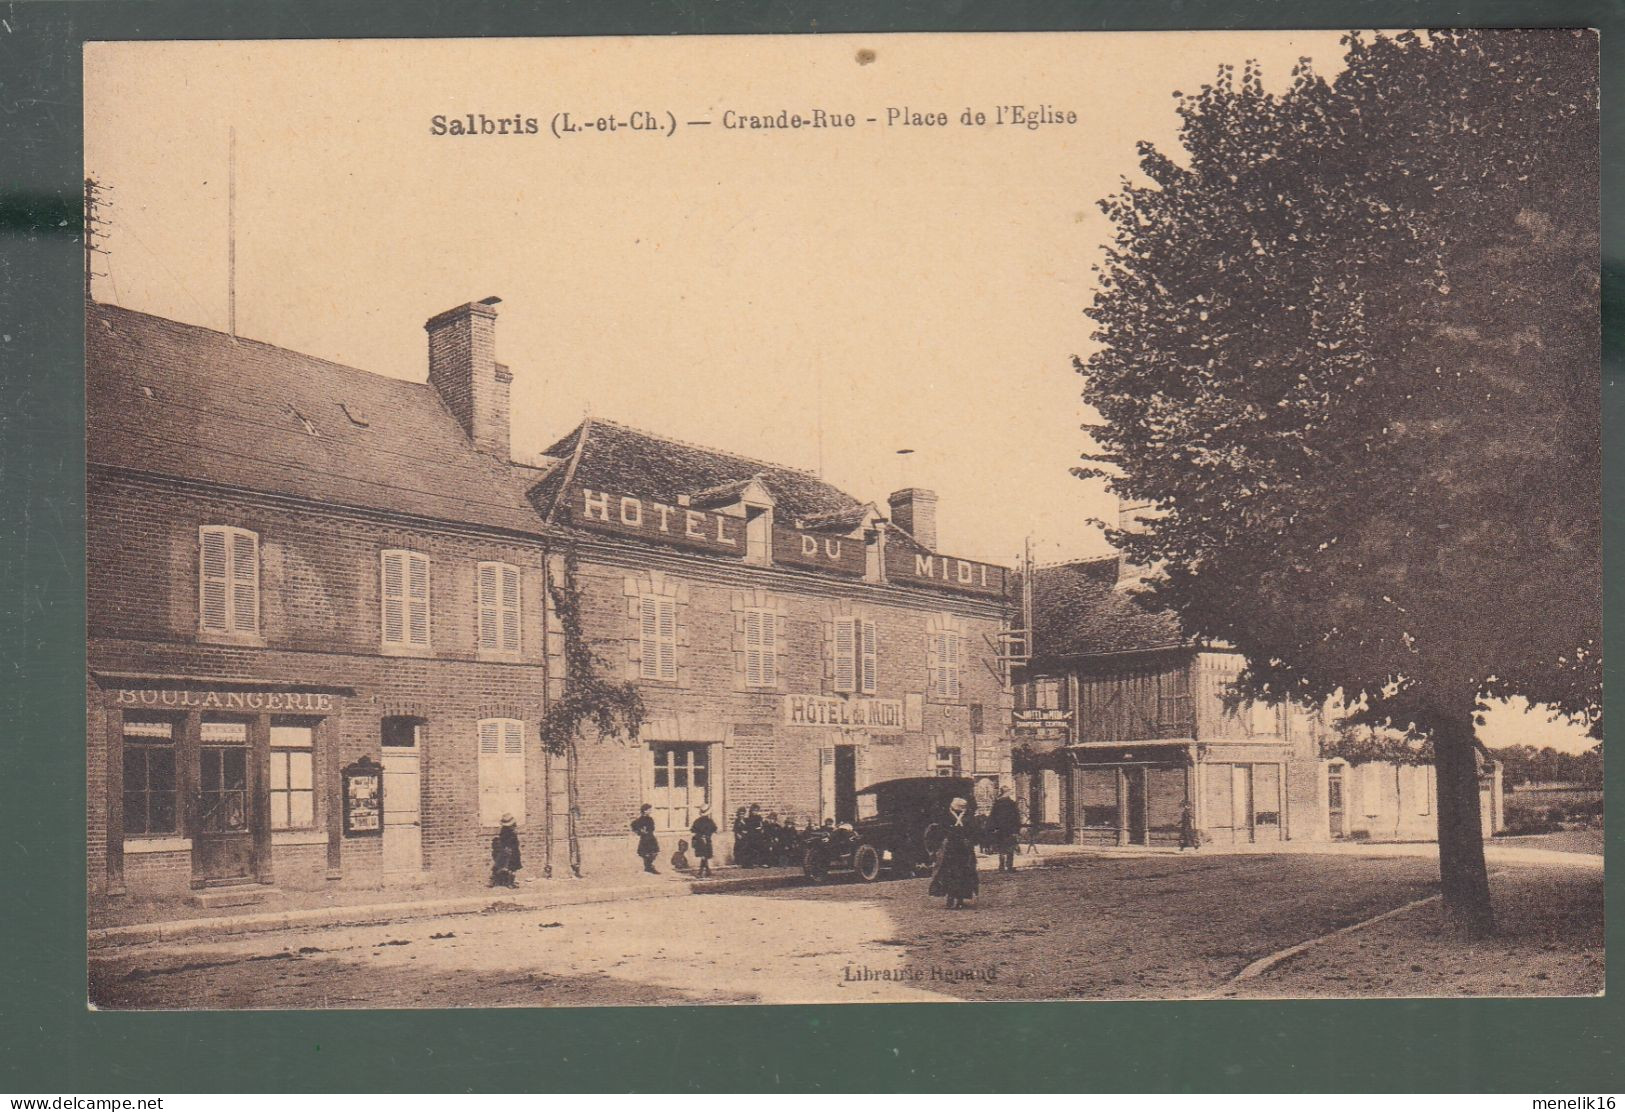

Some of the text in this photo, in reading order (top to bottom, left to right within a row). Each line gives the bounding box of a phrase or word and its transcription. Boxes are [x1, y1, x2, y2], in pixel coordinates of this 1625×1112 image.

[583, 488, 988, 588] HOTEL DU MIDI
[117, 689, 333, 711] BOULANGERIE
